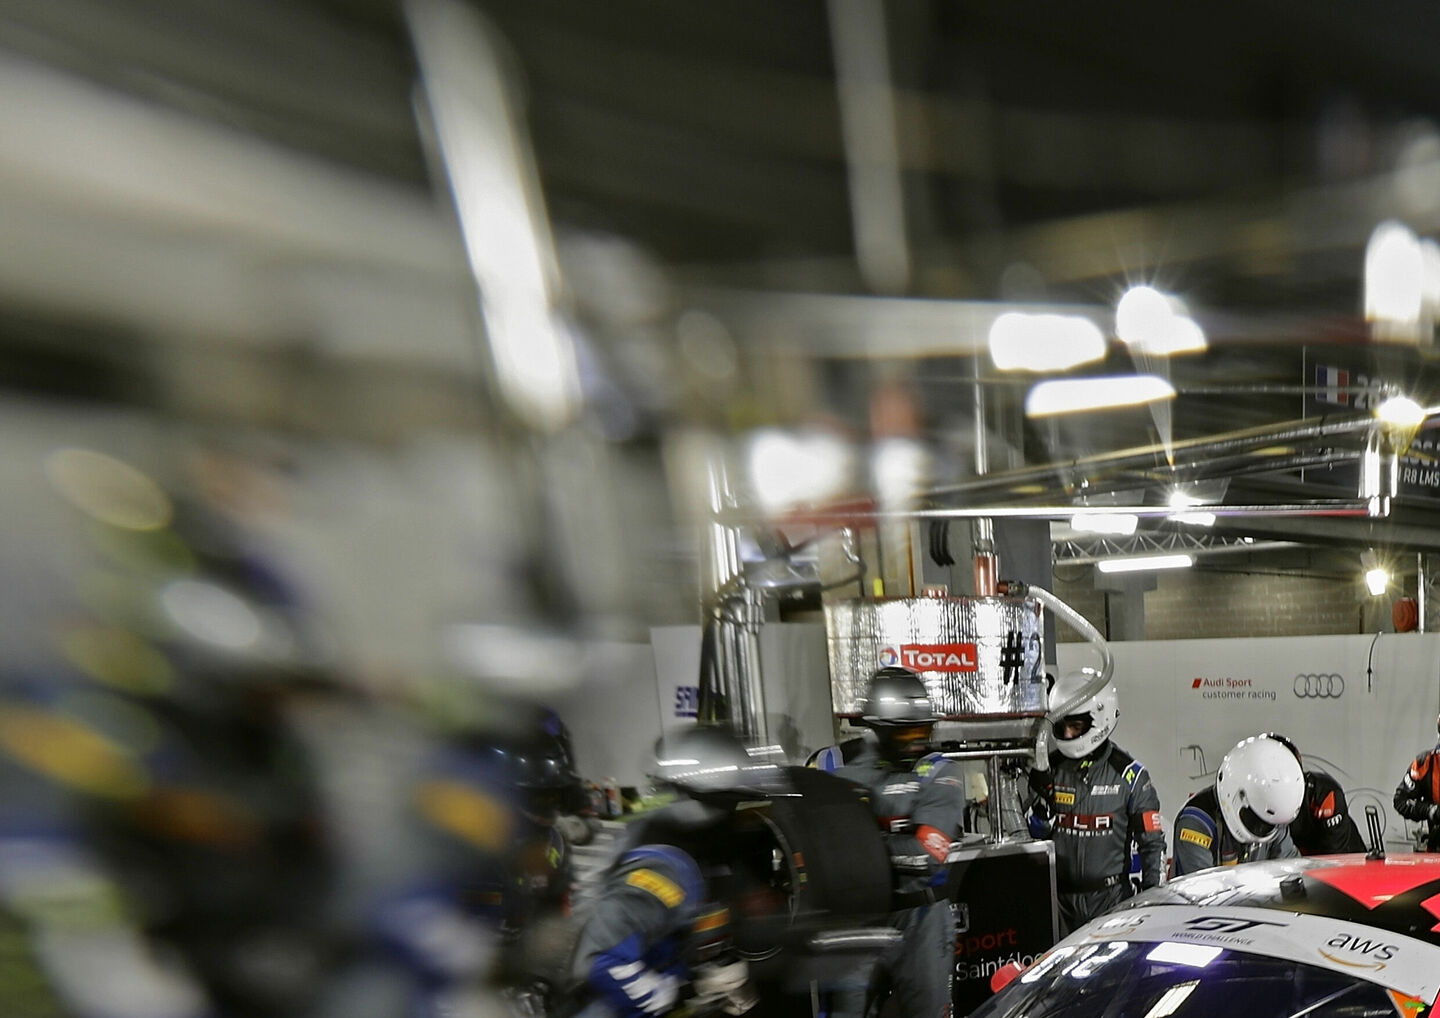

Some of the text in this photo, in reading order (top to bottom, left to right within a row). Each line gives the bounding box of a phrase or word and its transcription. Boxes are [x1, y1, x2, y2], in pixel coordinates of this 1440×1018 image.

[1419, 473, 1440, 487] LMS
[903, 649, 974, 667] TOTAL
[1203, 677, 1252, 689] Audi Sport
[1202, 689, 1277, 701] customer racing
[1327, 932, 1399, 961] aws
